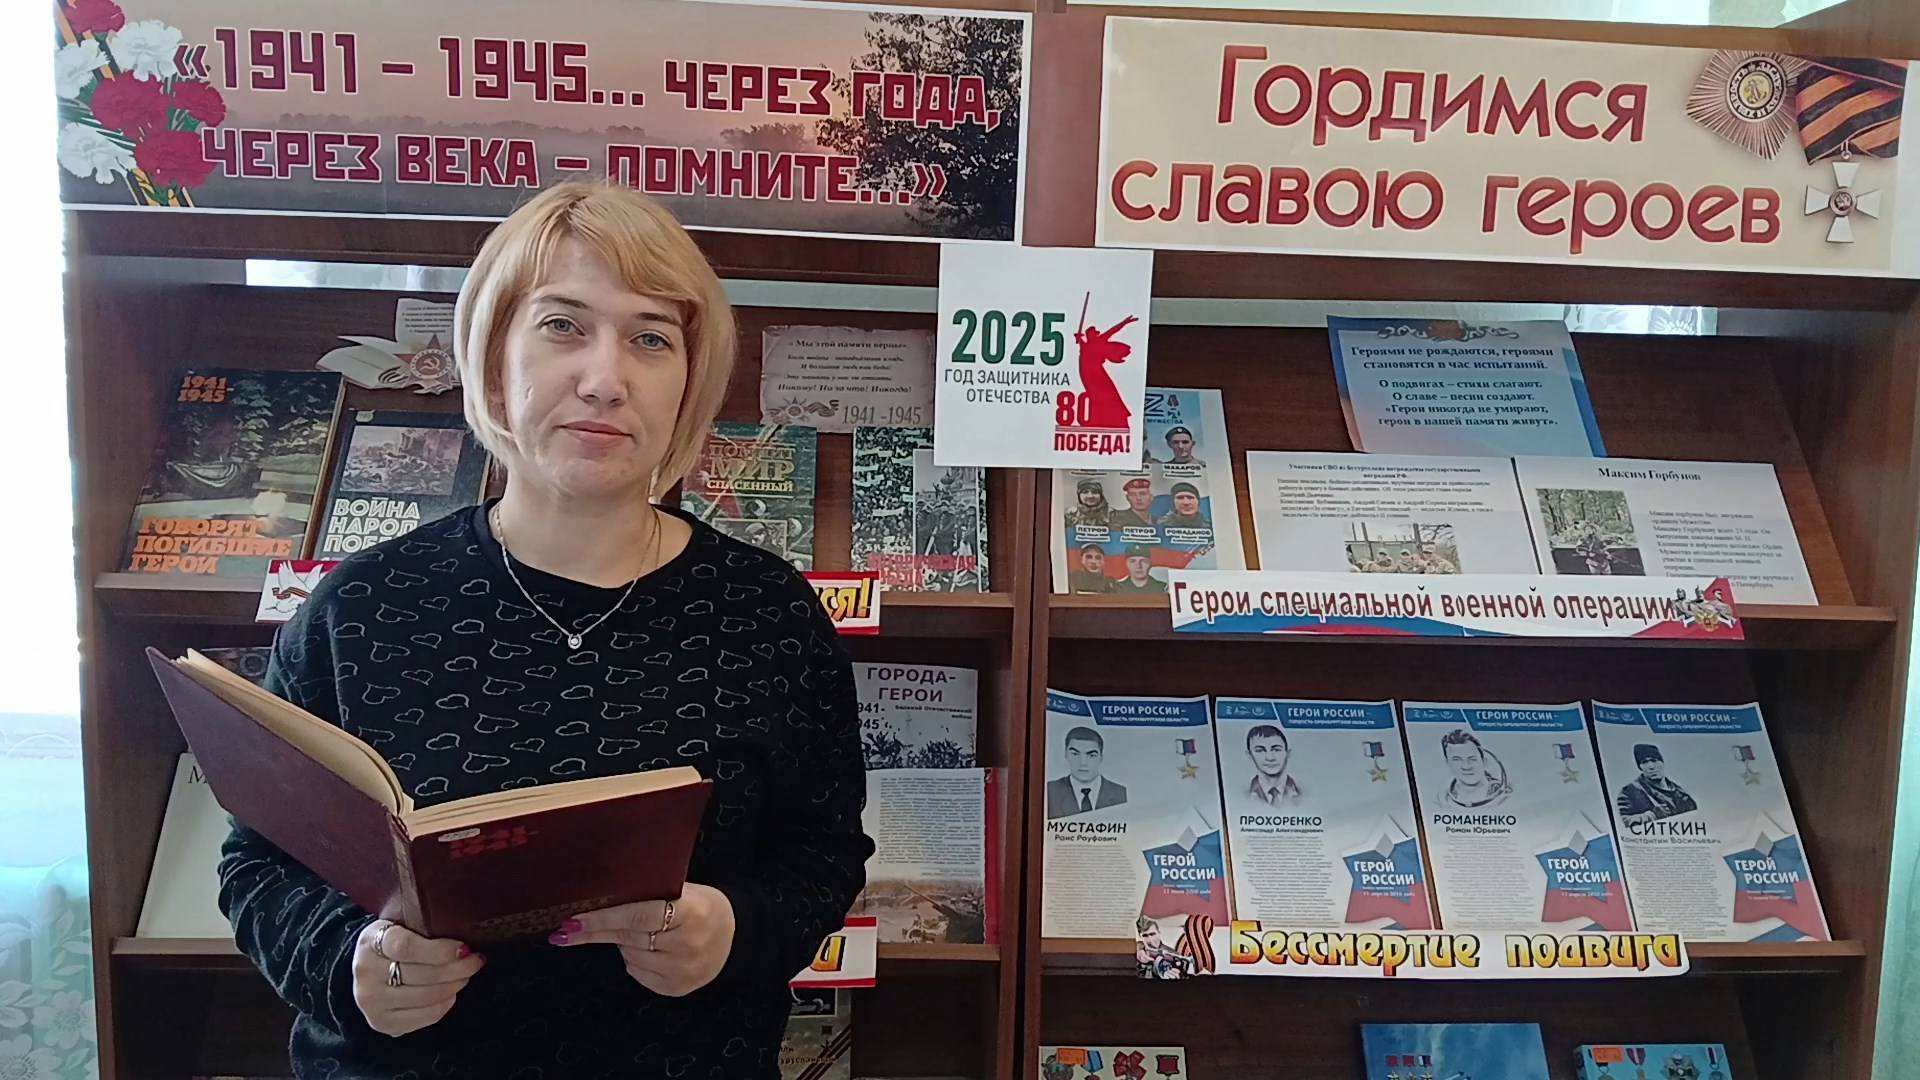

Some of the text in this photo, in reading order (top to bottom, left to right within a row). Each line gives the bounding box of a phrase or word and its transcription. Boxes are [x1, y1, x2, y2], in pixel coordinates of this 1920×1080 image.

[438, 36, 645, 107] 1945...
[664, 59, 833, 117] ЧЕРЕЗ
[850, 71, 1001, 132] ГОДА,
[1216, 43, 1649, 146] Гордимся
[201, 127, 381, 183] ЧЕРЕЗ
[396, 134, 540, 189] ВЕКА
[1109, 159, 1783, 255] славою героев
[952, 309, 1065, 366] 2025
[1351, 346, 1554, 358] Героями не рождаются, героями
[1363, 361, 1434, 369] становятся
[1438, 361, 1446, 369] в
[1448, 361, 1470, 369] час
[944, 369, 1070, 386] ГОД ЗАЩИТНИКА
[1379, 379, 1389, 388] О
[1392, 381, 1445, 389] подвигах
[177, 389, 226, 402] 1945
[966, 388, 1050, 405] ОТЕЧЕСТВА
[1392, 391, 1402, 401] О
[1405, 393, 1438, 401] славе
[1450, 393, 1484, 401] песни
[843, 405, 874, 424] 1941
[1056, 391, 1092, 427] 80
[1428, 406, 1475, 414] никогда
[1493, 406, 1549, 415] умирают,
[1378, 418, 1411, 427] герои
[1424, 416, 1462, 425] нашей
[1465, 418, 1508, 426] памяти
[1054, 433, 1131, 455] ПОБЕДА!
[709, 458, 795, 481] МИР
[1598, 467, 1702, 482] Максим Горбунов
[706, 479, 794, 492] СПАСЕННЫЙ
[332, 496, 420, 519] ВОЙНА
[138, 517, 259, 536] ГОВОРЯТ
[1077, 526, 1108, 534] ПЕТРОВ
[1124, 527, 1155, 535] ПЕТРОВ
[133, 535, 293, 557] ПОГИБШИЕ
[128, 554, 220, 574] ГЕРОИ
[1173, 581, 1677, 627] Герои специальной военной операции
[867, 667, 957, 685] ГОРОДА-
[879, 687, 943, 702] ГЕРОИ
[857, 702, 886, 714] 941-
[1102, 705, 1135, 715] ГЕРОИ
[1287, 707, 1320, 717] ГЕРОИ
[1476, 710, 1509, 720] ГЕРОИ
[1655, 712, 1688, 722] ГЕРОИ
[1239, 815, 1322, 826] ПРОХОРЕНКО
[1433, 814, 1517, 826] РОМАНЕНКО
[1047, 821, 1127, 834] МУСТАФИН
[1473, 826, 1511, 834] Юрьевич
[1629, 821, 1707, 836] СИТКИН
[1076, 835, 1117, 843] Рауфович
[1153, 852, 1196, 867] ГЕРОЙ
[1353, 858, 1395, 872] ГЕРОЙ
[1547, 856, 1589, 870] ГЕРОЙ
[1734, 856, 1777, 871] ГЕРОЙ
[1161, 867, 1216, 880] РОССИИ
[1361, 873, 1415, 886] РОССИИ
[1556, 870, 1611, 884] РОССИИ
[1744, 870, 1799, 885] РОССИИ
[1228, 919, 1682, 976] Бессмертие подвига
